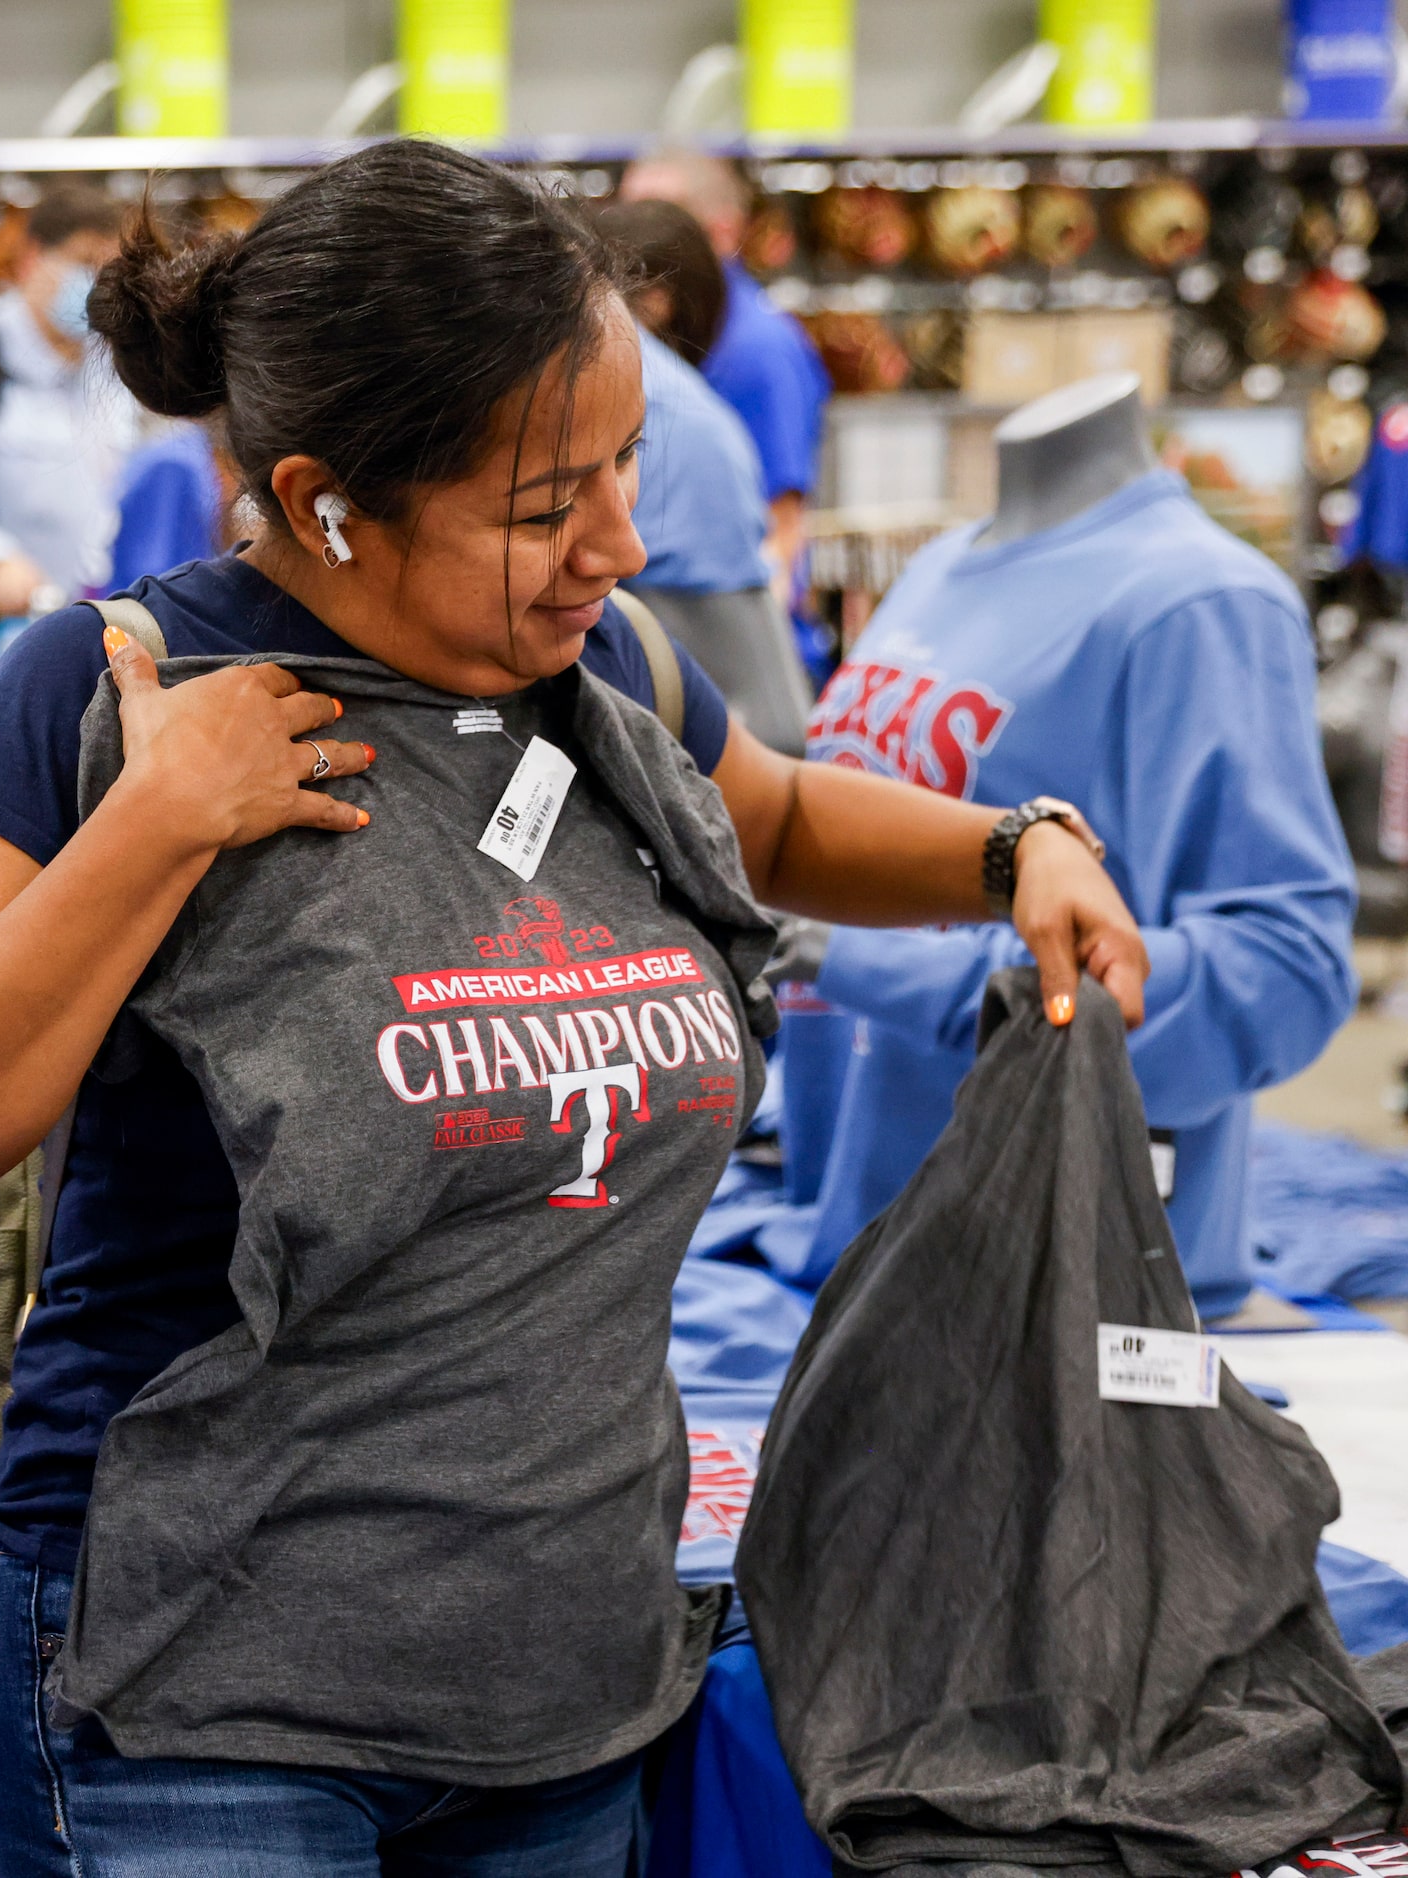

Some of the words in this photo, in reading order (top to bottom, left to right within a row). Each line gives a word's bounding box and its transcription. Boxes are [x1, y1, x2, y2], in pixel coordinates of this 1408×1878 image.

[495, 805, 520, 832] 40
[473, 933, 520, 959] 20
[569, 925, 615, 953] 23
[410, 971, 583, 1005] AMERICAN
[588, 952, 697, 990] LEAGUE
[376, 989, 742, 1104] CHAMPIONS
[435, 1129, 468, 1145] FALL
[470, 1122, 527, 1143] CLASSIC
